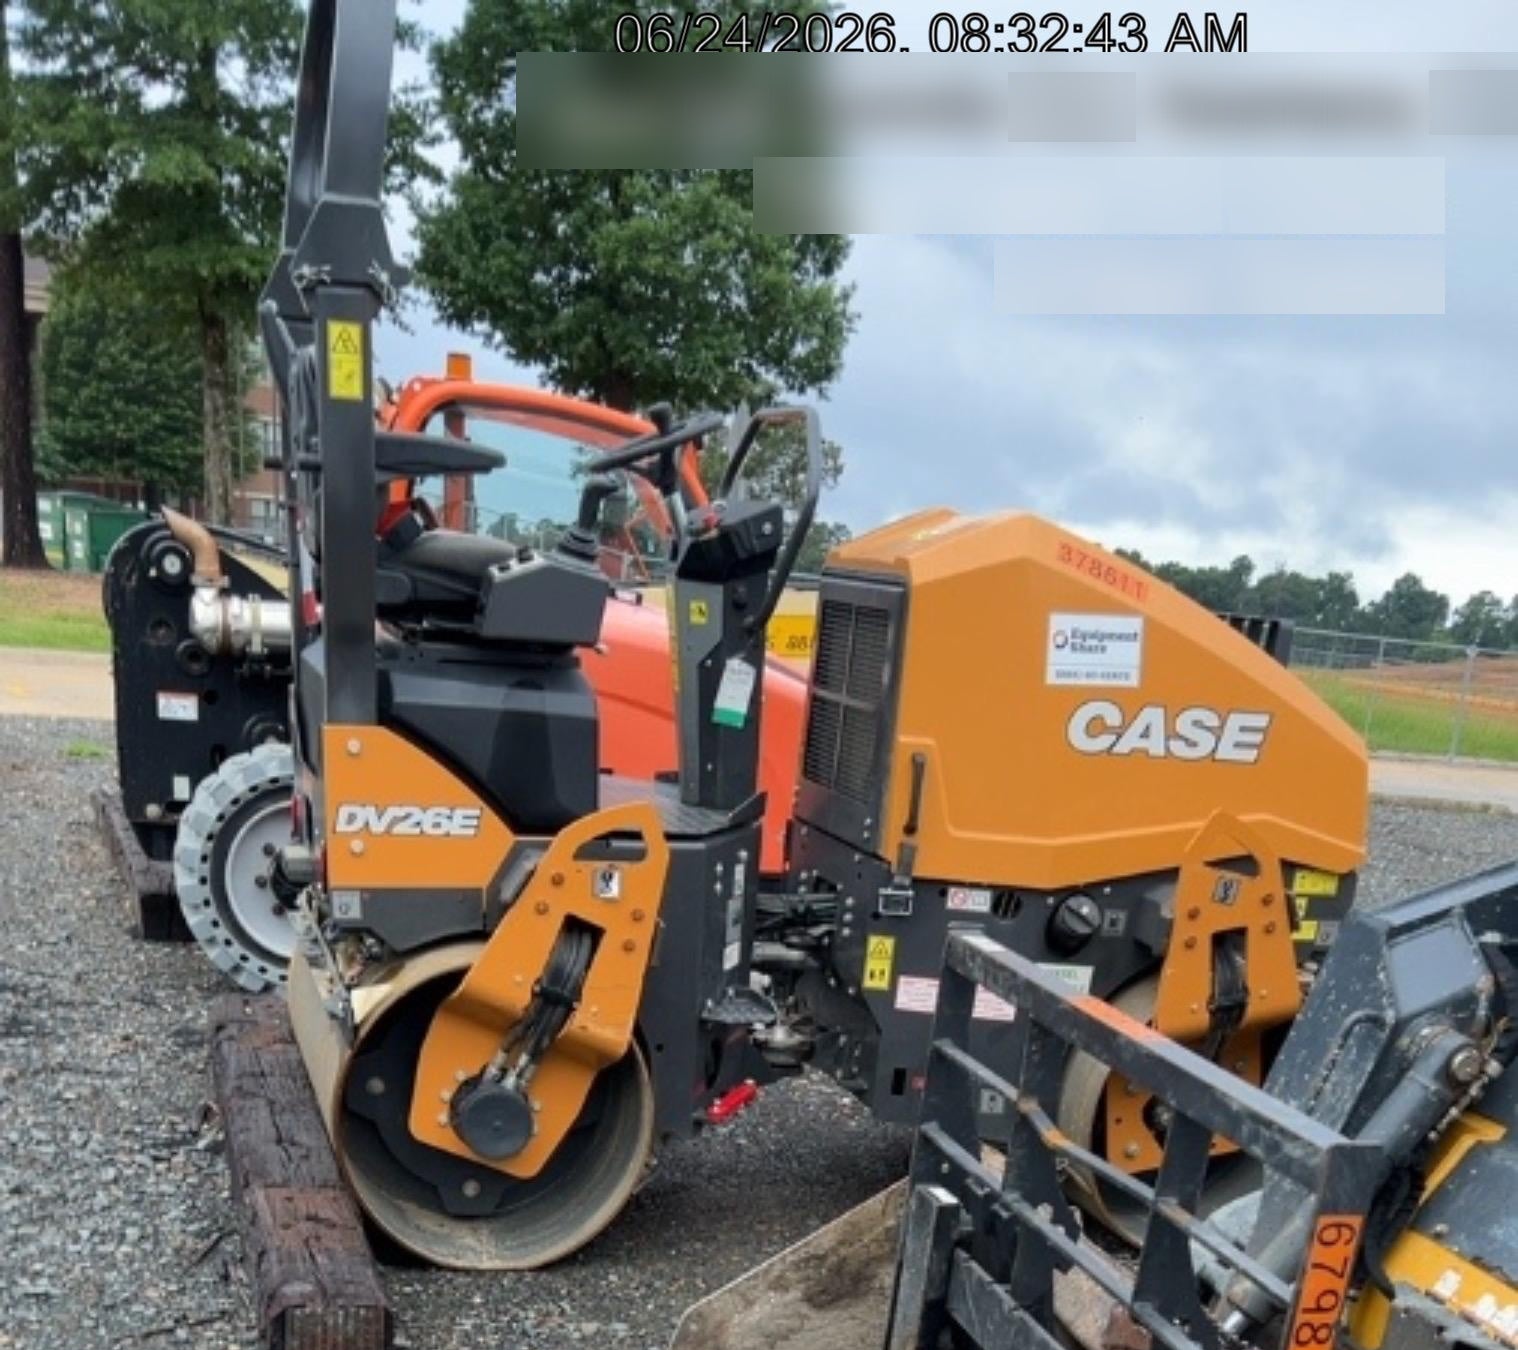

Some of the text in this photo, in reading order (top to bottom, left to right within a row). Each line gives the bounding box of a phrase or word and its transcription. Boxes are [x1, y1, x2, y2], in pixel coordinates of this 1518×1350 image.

[1070, 627, 1138, 643] Equipment
[1066, 699, 1271, 764] CASE
[334, 804, 482, 836] DV26E
